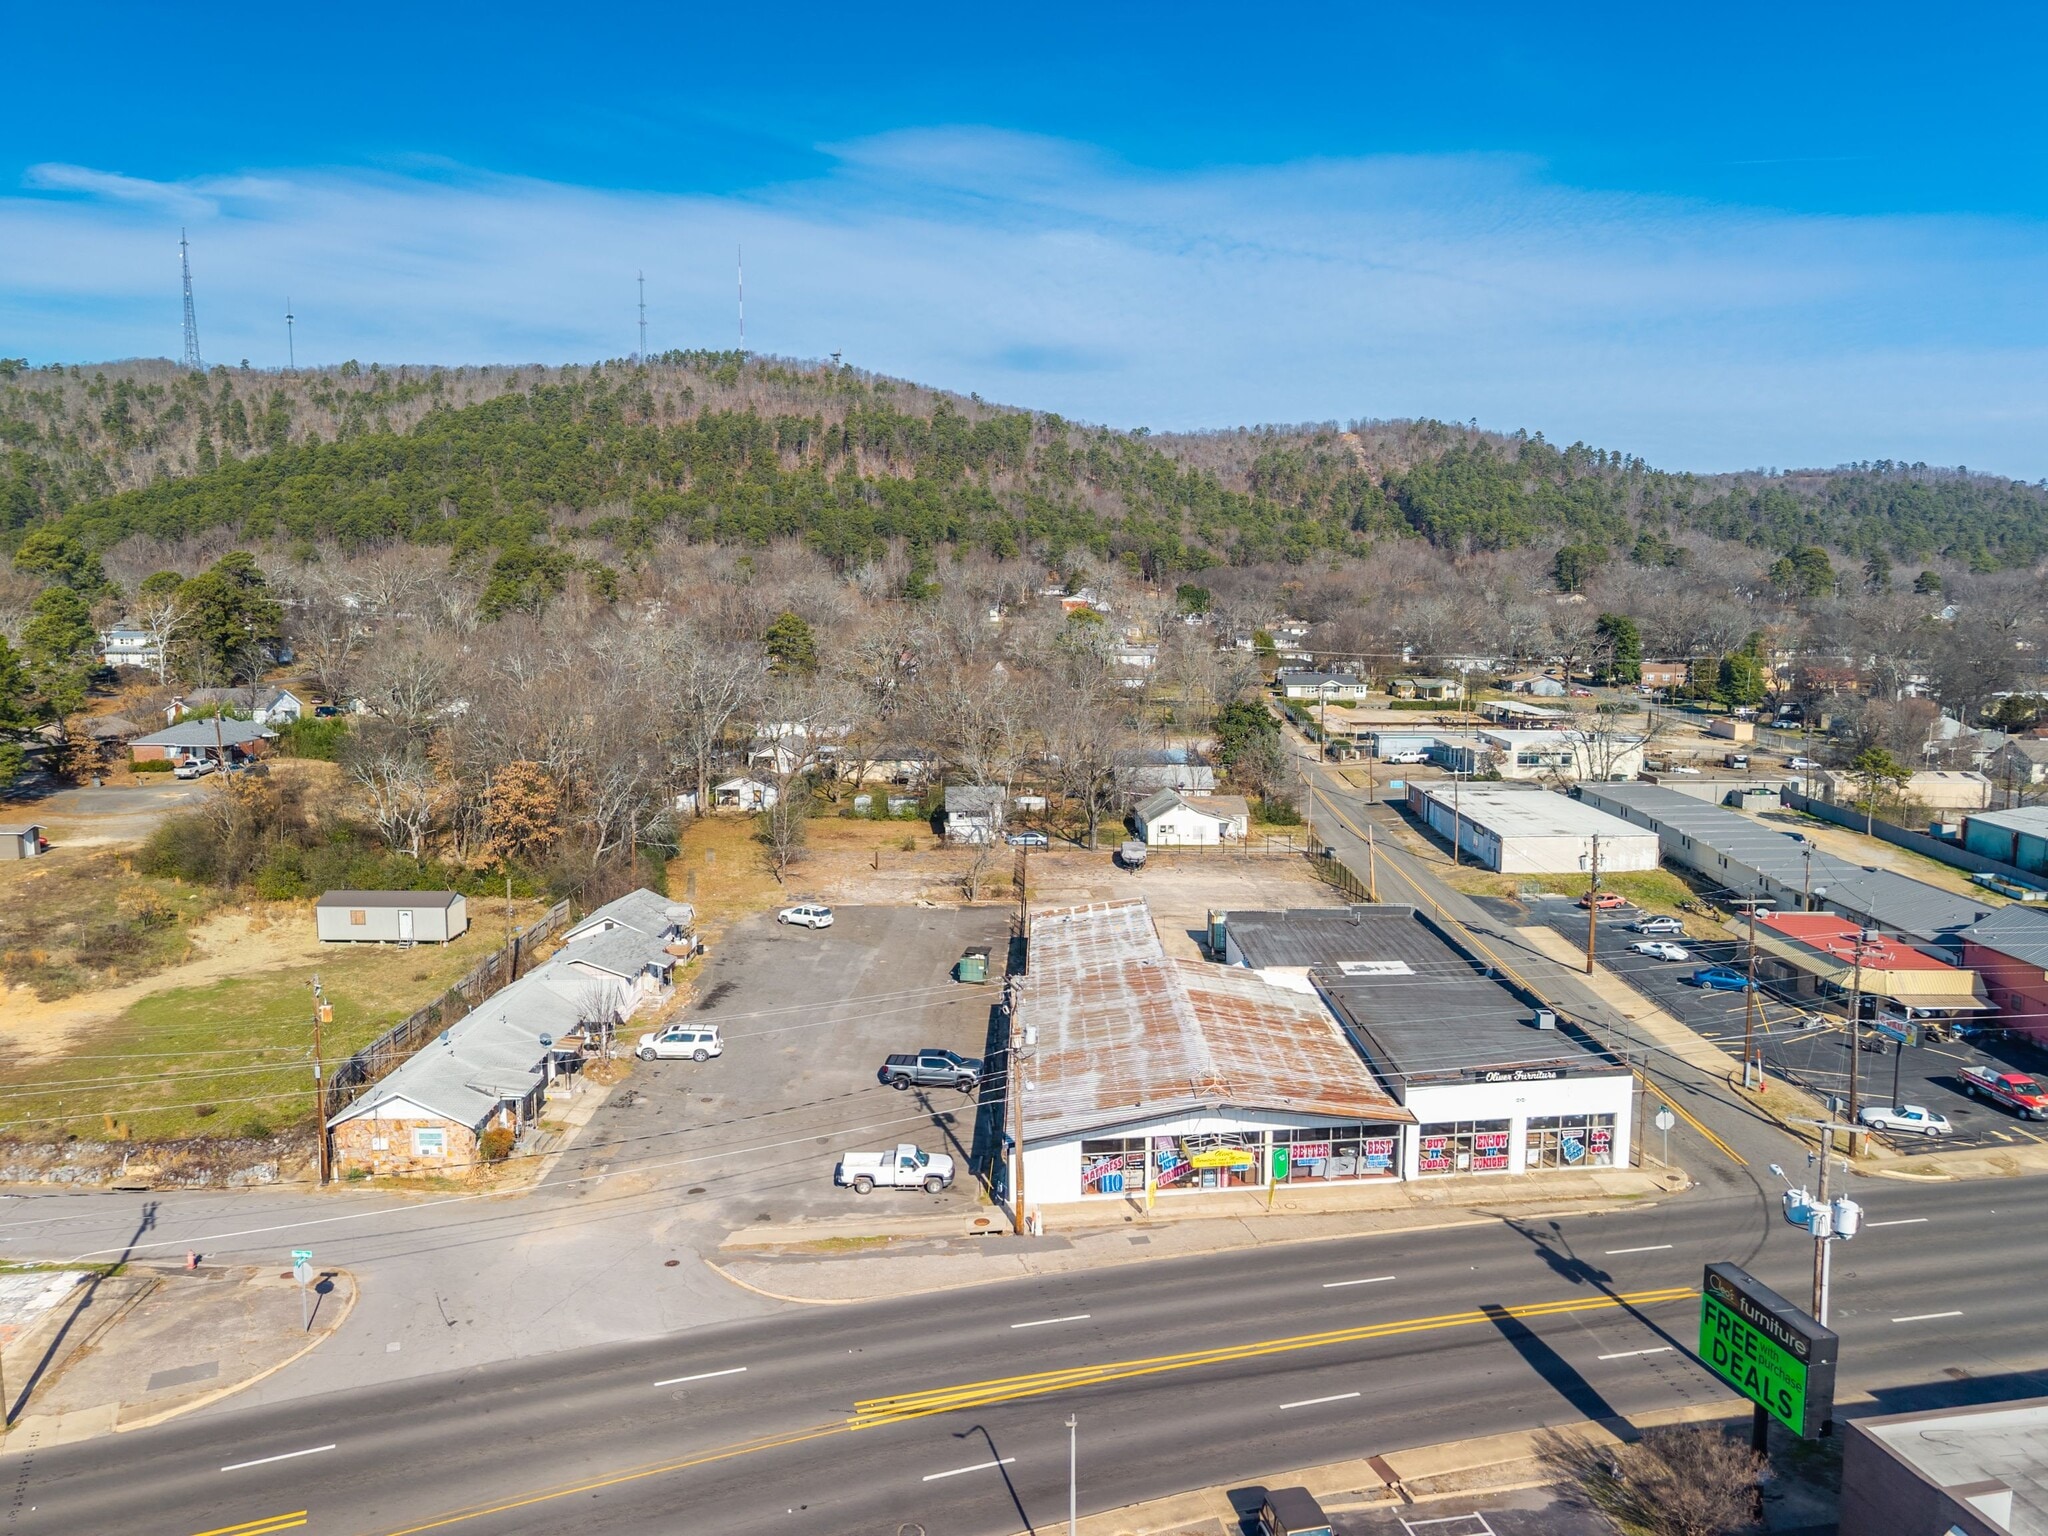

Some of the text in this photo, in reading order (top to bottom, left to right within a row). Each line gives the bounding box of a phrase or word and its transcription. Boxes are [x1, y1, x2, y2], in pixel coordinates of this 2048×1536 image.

[1486, 1070, 1557, 1082] Oliver Furniture
[1367, 1140, 1392, 1155] BEST
[1426, 1138, 1446, 1149] BUY
[1476, 1134, 1507, 1148] ENJOY
[1158, 1150, 1170, 1163] ALL
[1291, 1144, 1329, 1158] BETTER
[1430, 1149, 1440, 1158] IT
[1486, 1147, 1497, 1156] IT
[1082, 1156, 1123, 1184] MATTRESS
[1162, 1157, 1178, 1171] NEW
[1420, 1159, 1449, 1169] TODAY
[1473, 1157, 1508, 1169] TONIGHT
[1157, 1162, 1192, 1187] FURNITUR
[1102, 1173, 1123, 1192] HQ
[1704, 1300, 1759, 1361] FREE
[1740, 1297, 1807, 1355] furniture
[1759, 1341, 1779, 1361] with
[1712, 1336, 1793, 1419] DEALS
[1758, 1354, 1803, 1393] purchase
